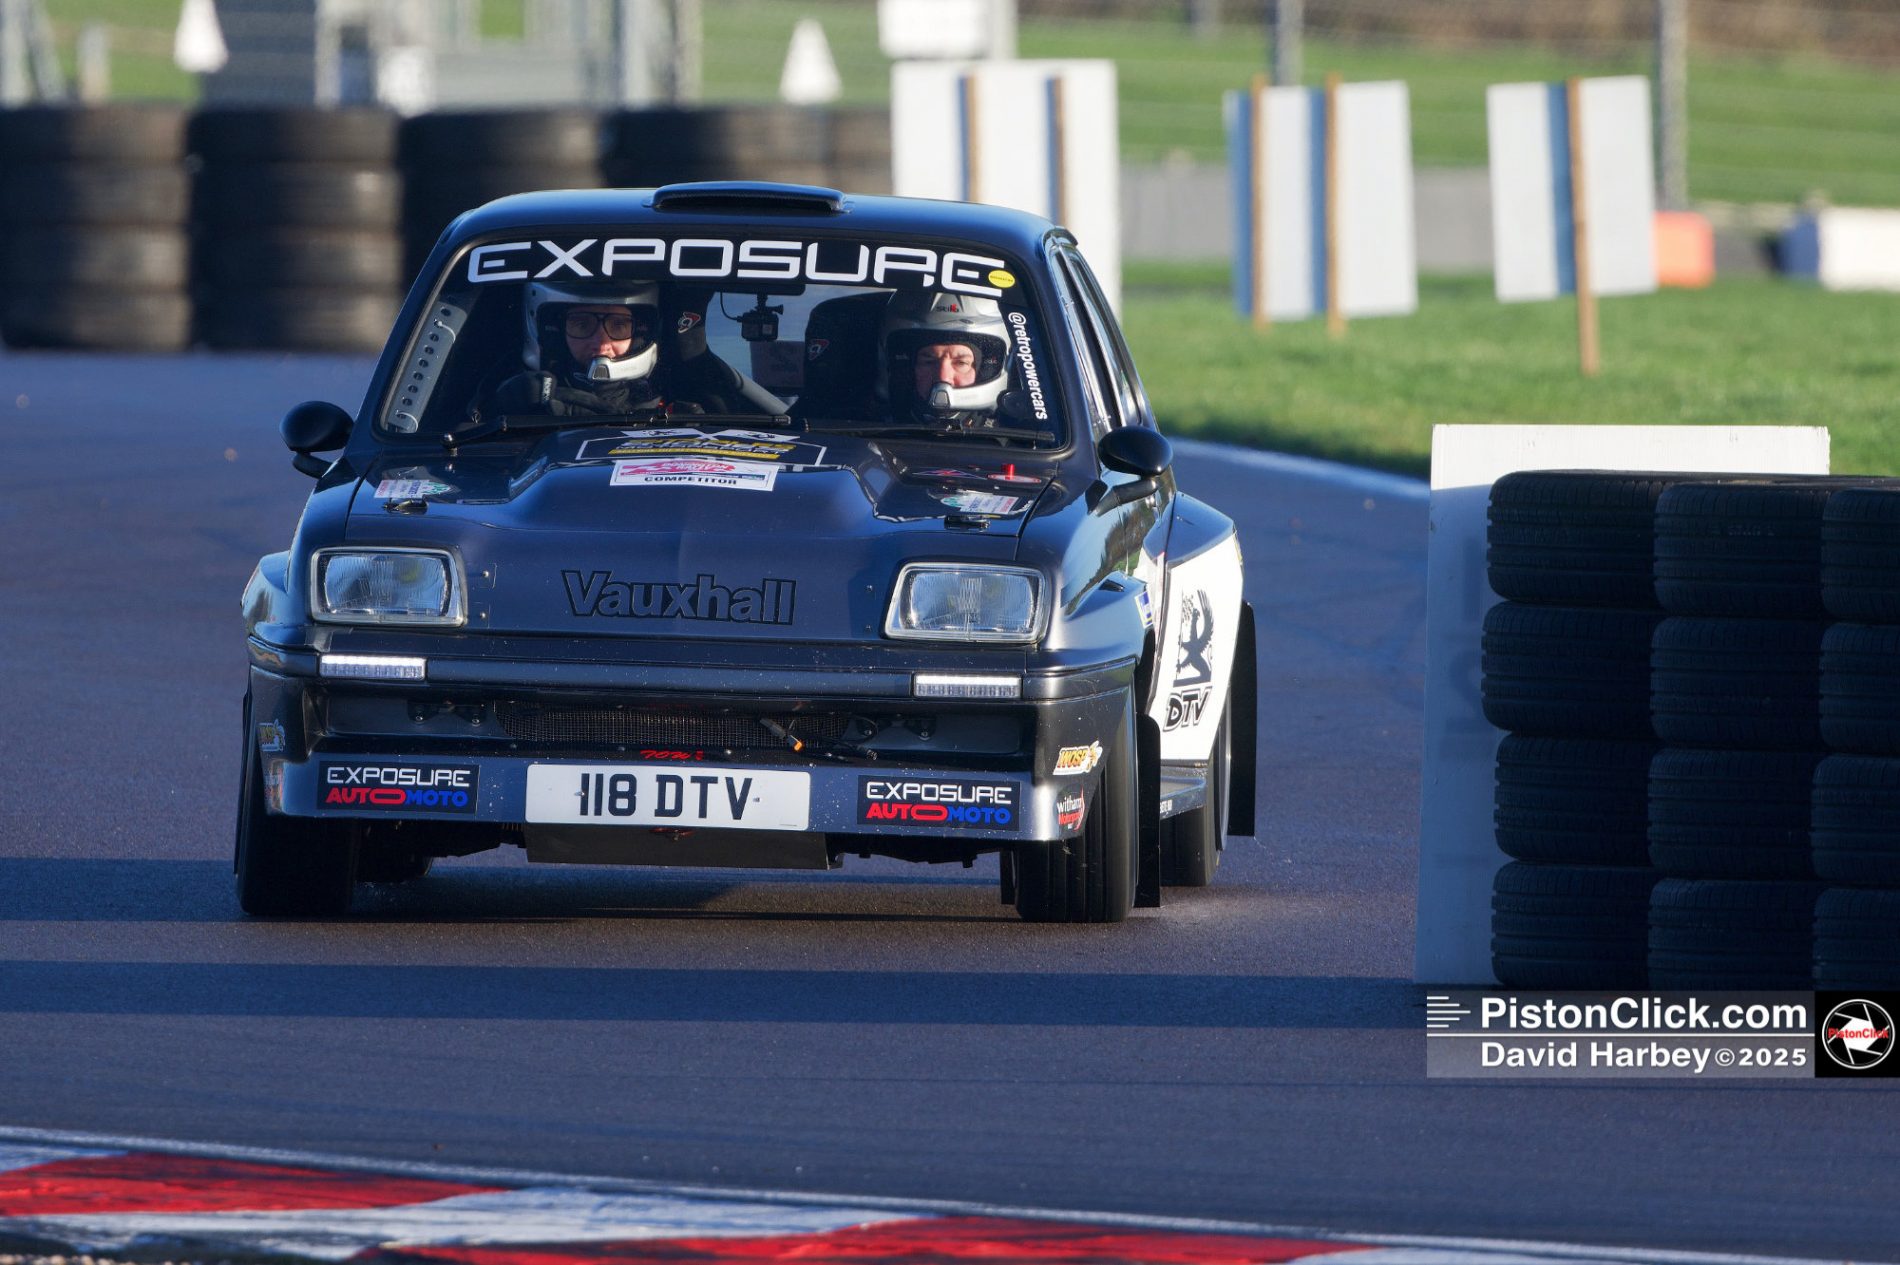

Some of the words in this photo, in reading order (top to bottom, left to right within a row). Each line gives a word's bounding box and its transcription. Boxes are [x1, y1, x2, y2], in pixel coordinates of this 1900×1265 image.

[468, 237, 1005, 297] EXPOSURE
[1008, 312, 1048, 421] @retropowercars
[644, 476, 737, 485] COMPETITOR
[561, 570, 796, 625] Vauxhall
[1163, 686, 1213, 732] DTV
[327, 766, 471, 788] EXPOSURE
[1056, 748, 1088, 769] WOSP
[580, 772, 637, 817] 118
[654, 773, 753, 820] DTV
[866, 781, 1012, 805] EXPOSURE
